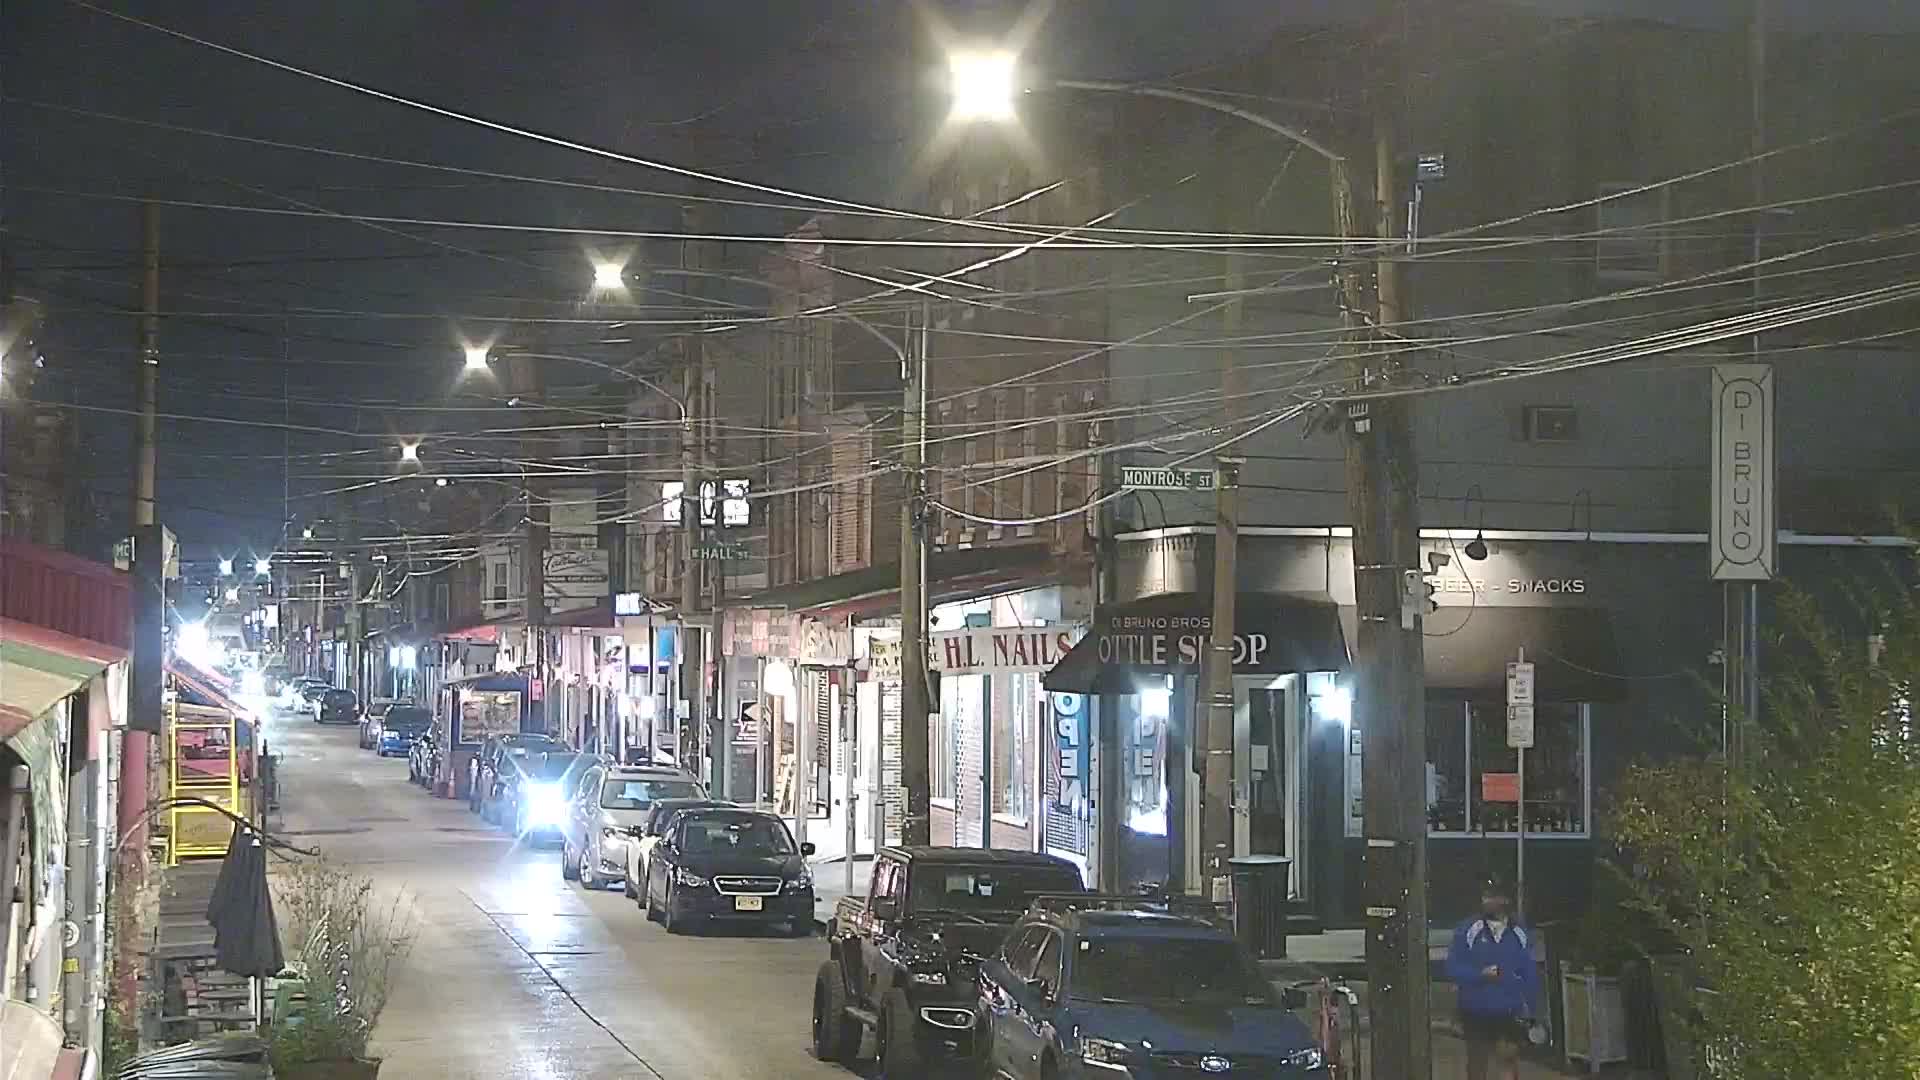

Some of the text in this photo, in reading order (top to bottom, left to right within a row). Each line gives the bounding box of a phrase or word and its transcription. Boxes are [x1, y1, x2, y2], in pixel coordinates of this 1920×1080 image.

[1732, 390, 1751, 549] DI BRUNO
[1124, 470, 1211, 487] MONTROSE ST
[701, 547, 733, 560] HALL
[1431, 578, 1485, 593] BEER
[1508, 579, 1585, 593] SNACKS
[1123, 617, 1167, 629] BRUNO
[1171, 617, 1211, 629] BROS
[944, 632, 1073, 668] H.L. NAILS
